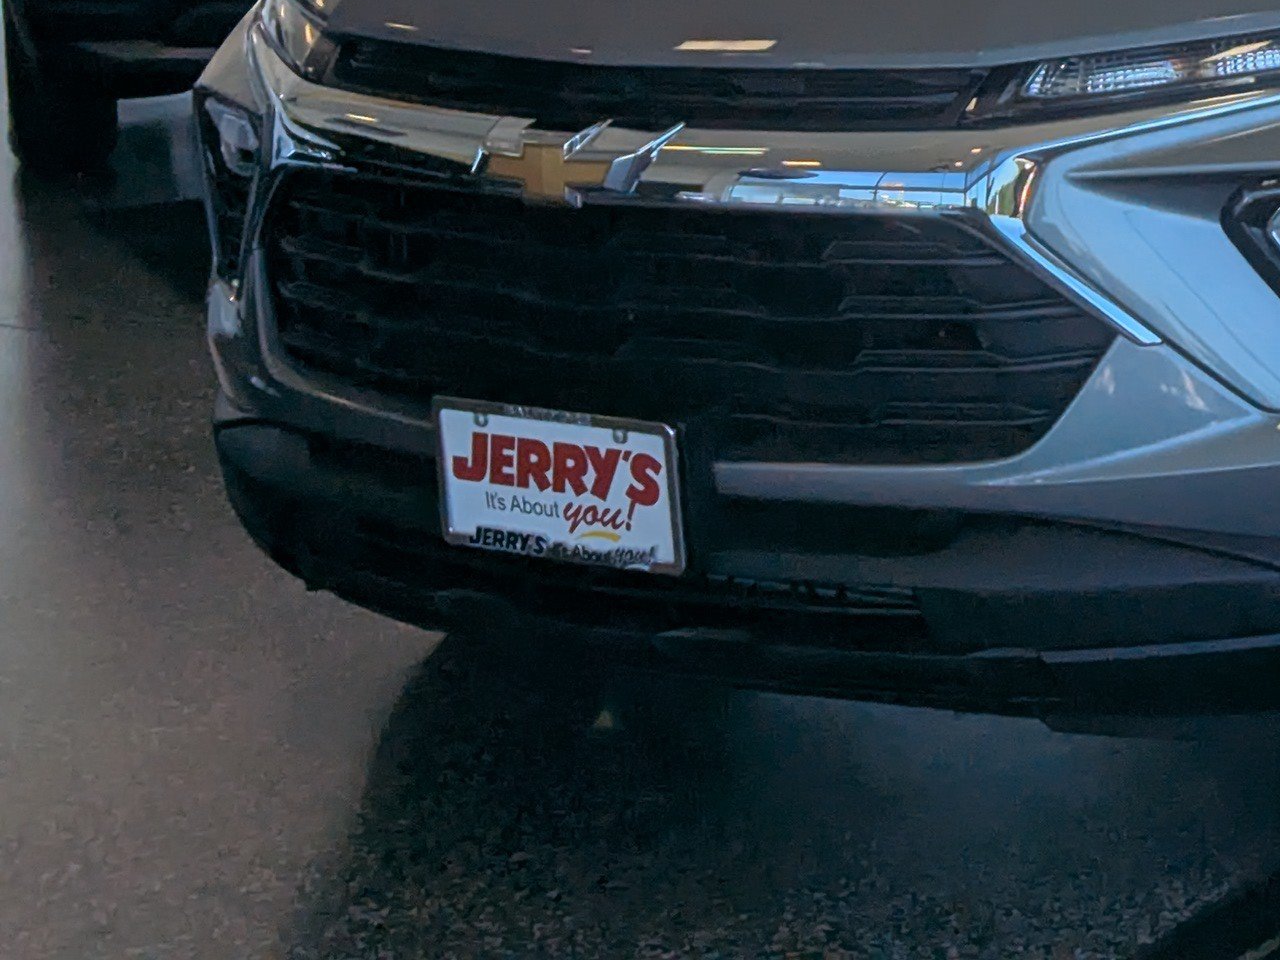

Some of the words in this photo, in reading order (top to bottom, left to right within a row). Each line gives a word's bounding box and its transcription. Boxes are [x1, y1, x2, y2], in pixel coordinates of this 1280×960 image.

[452, 431, 662, 507] JERRY'S
[485, 490, 507, 511] It's
[510, 493, 560, 518] About
[562, 499, 636, 534] you!
[469, 525, 549, 554] JERRY'S
